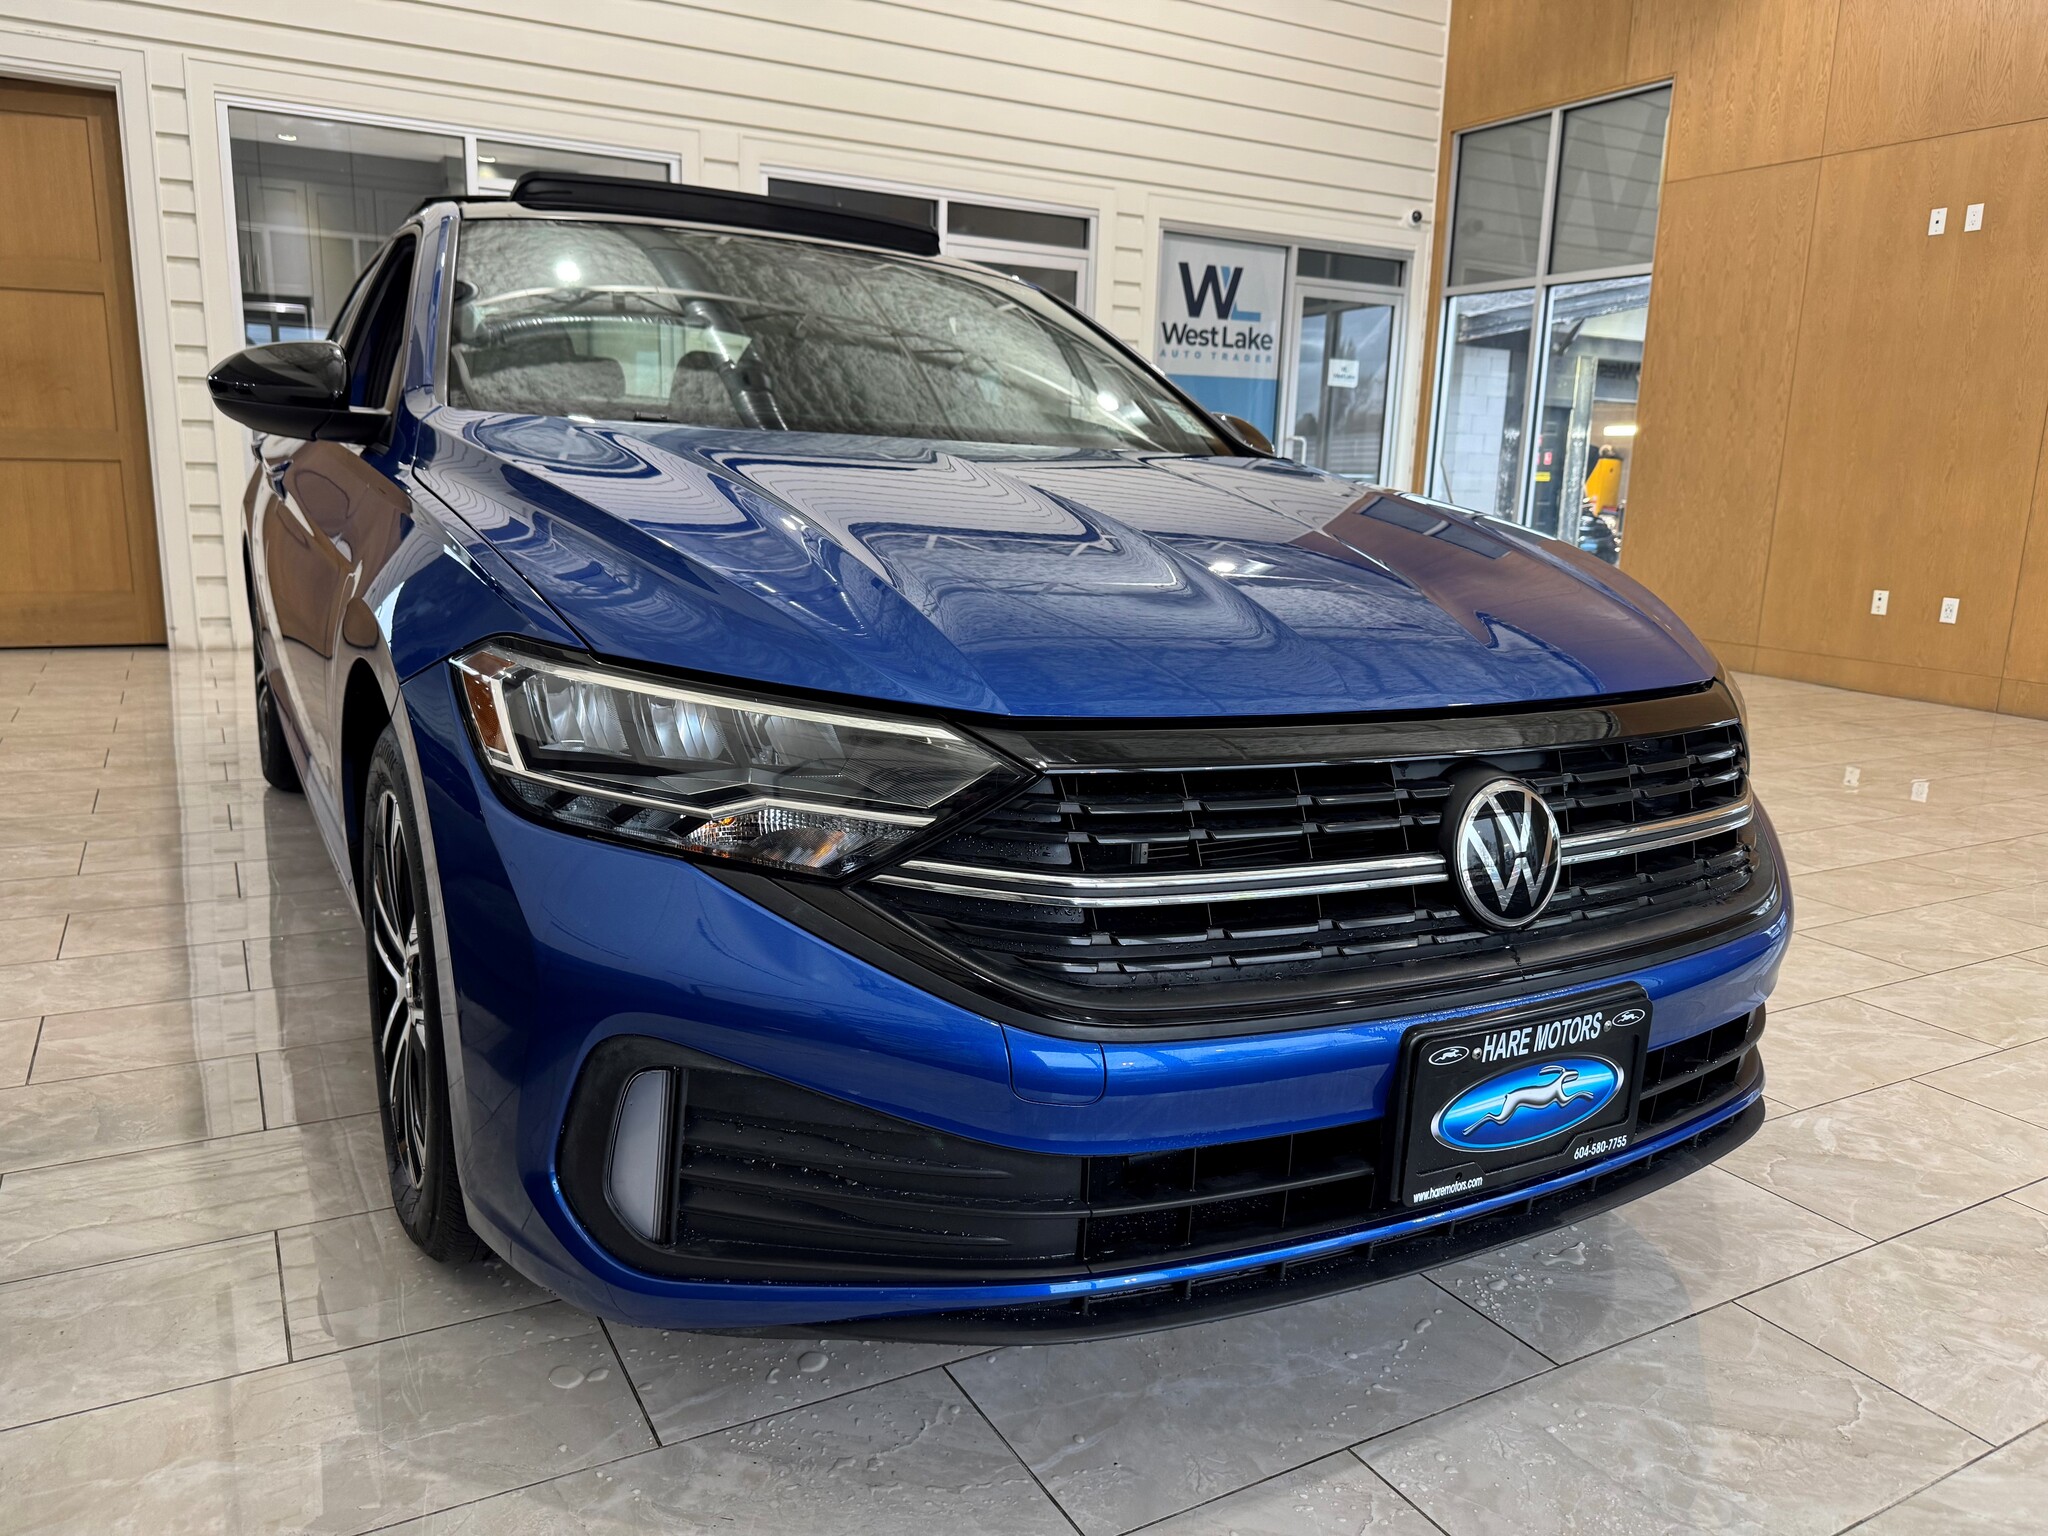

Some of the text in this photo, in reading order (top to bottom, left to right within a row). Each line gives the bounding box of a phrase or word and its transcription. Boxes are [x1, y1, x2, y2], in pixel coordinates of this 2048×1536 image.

[1159, 349, 1273, 363] AUTO TRADER
[1481, 1011, 1603, 1063] HARE MOTORS
[1573, 1134, 1628, 1160] 604-580-7755
[1413, 1176, 1484, 1204] www.haremotors.com
